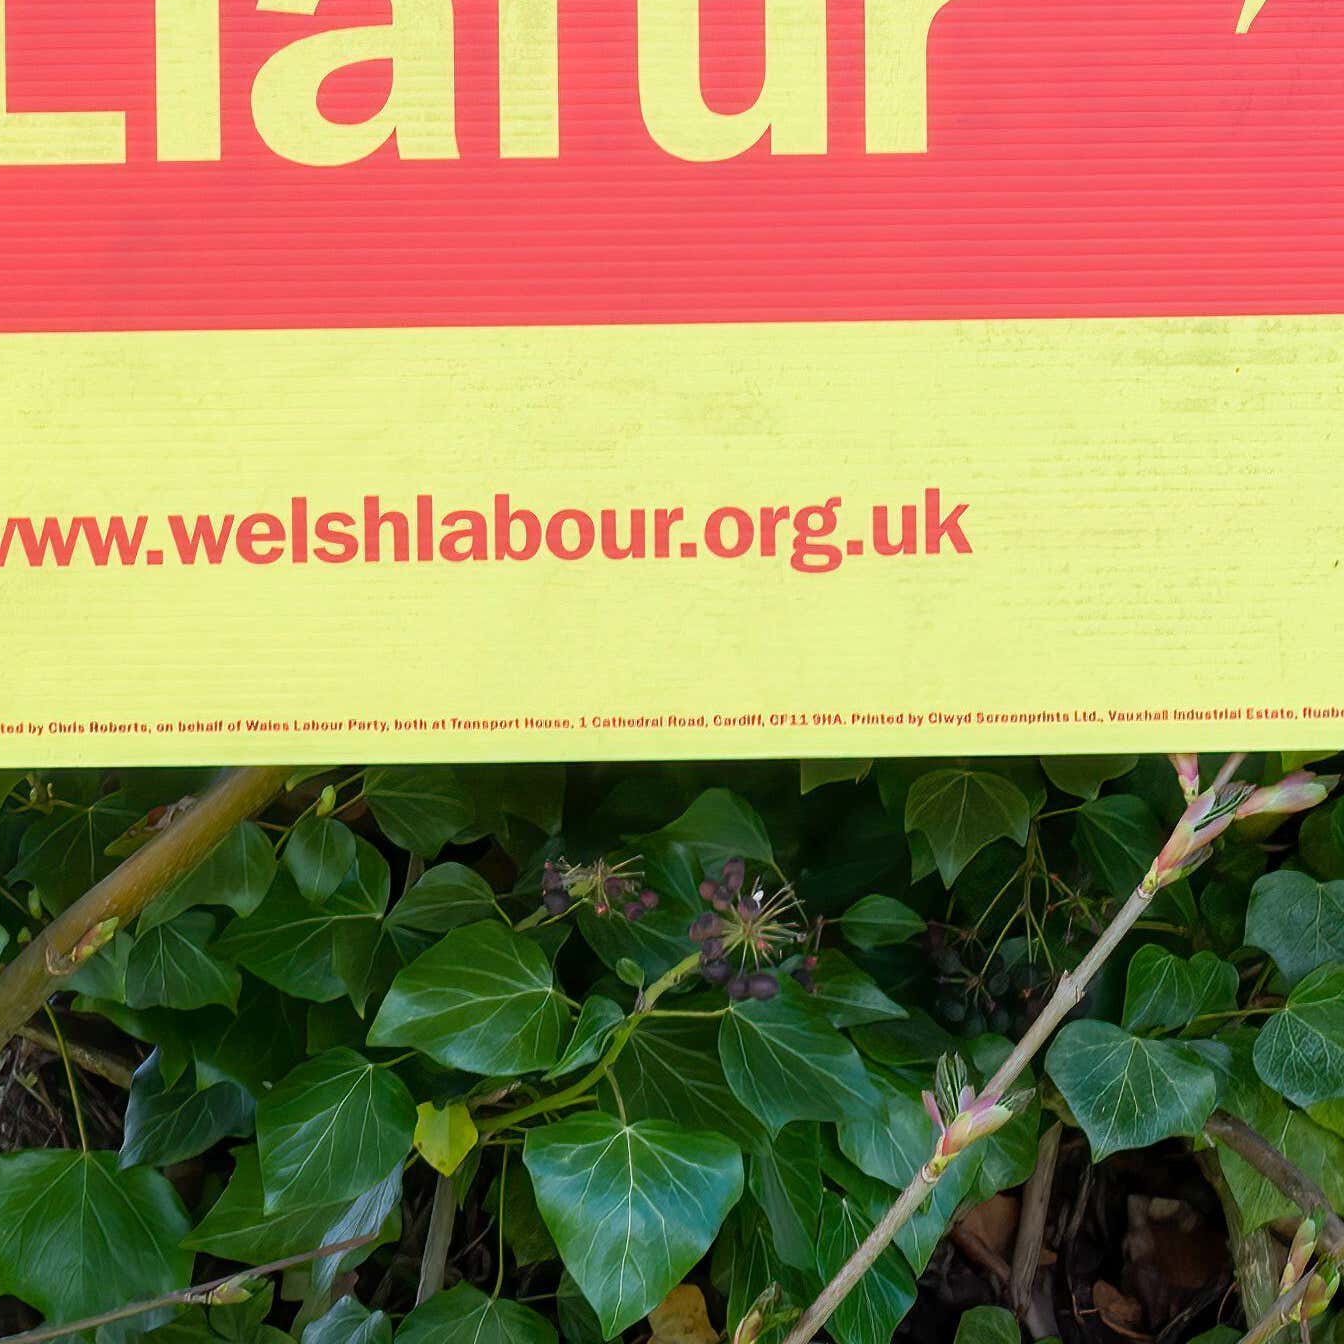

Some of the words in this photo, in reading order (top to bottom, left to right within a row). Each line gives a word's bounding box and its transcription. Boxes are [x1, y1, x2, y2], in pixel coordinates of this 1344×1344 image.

[28, 721, 44, 737] by
[48, 720, 85, 734] Chris
[88, 720, 152, 735] Roberts,
[156, 723, 174, 733] on
[176, 720, 224, 733] behalf
[227, 720, 243, 733] of
[246, 720, 289, 733] Wales
[292, 719, 345, 732] Labour
[348, 719, 390, 734] Party,
[394, 719, 427, 731] both
[430, 719, 447, 731] at
[450, 718, 521, 733] Transport
[579, 716, 588, 728] 1
[592, 715, 663, 728] Cathedral
[666, 715, 709, 730] Road,
[713, 713, 766, 729] Cardiff,
[770, 712, 809, 726] CF11
[852, 712, 904, 726] Printed
[908, 712, 924, 728] by
[928, 711, 972, 727] Clwyd
[975, 710, 1070, 726] Screenprints
[1108, 709, 1169, 723] Vauxhall
[1174, 708, 1242, 722] Industrial
